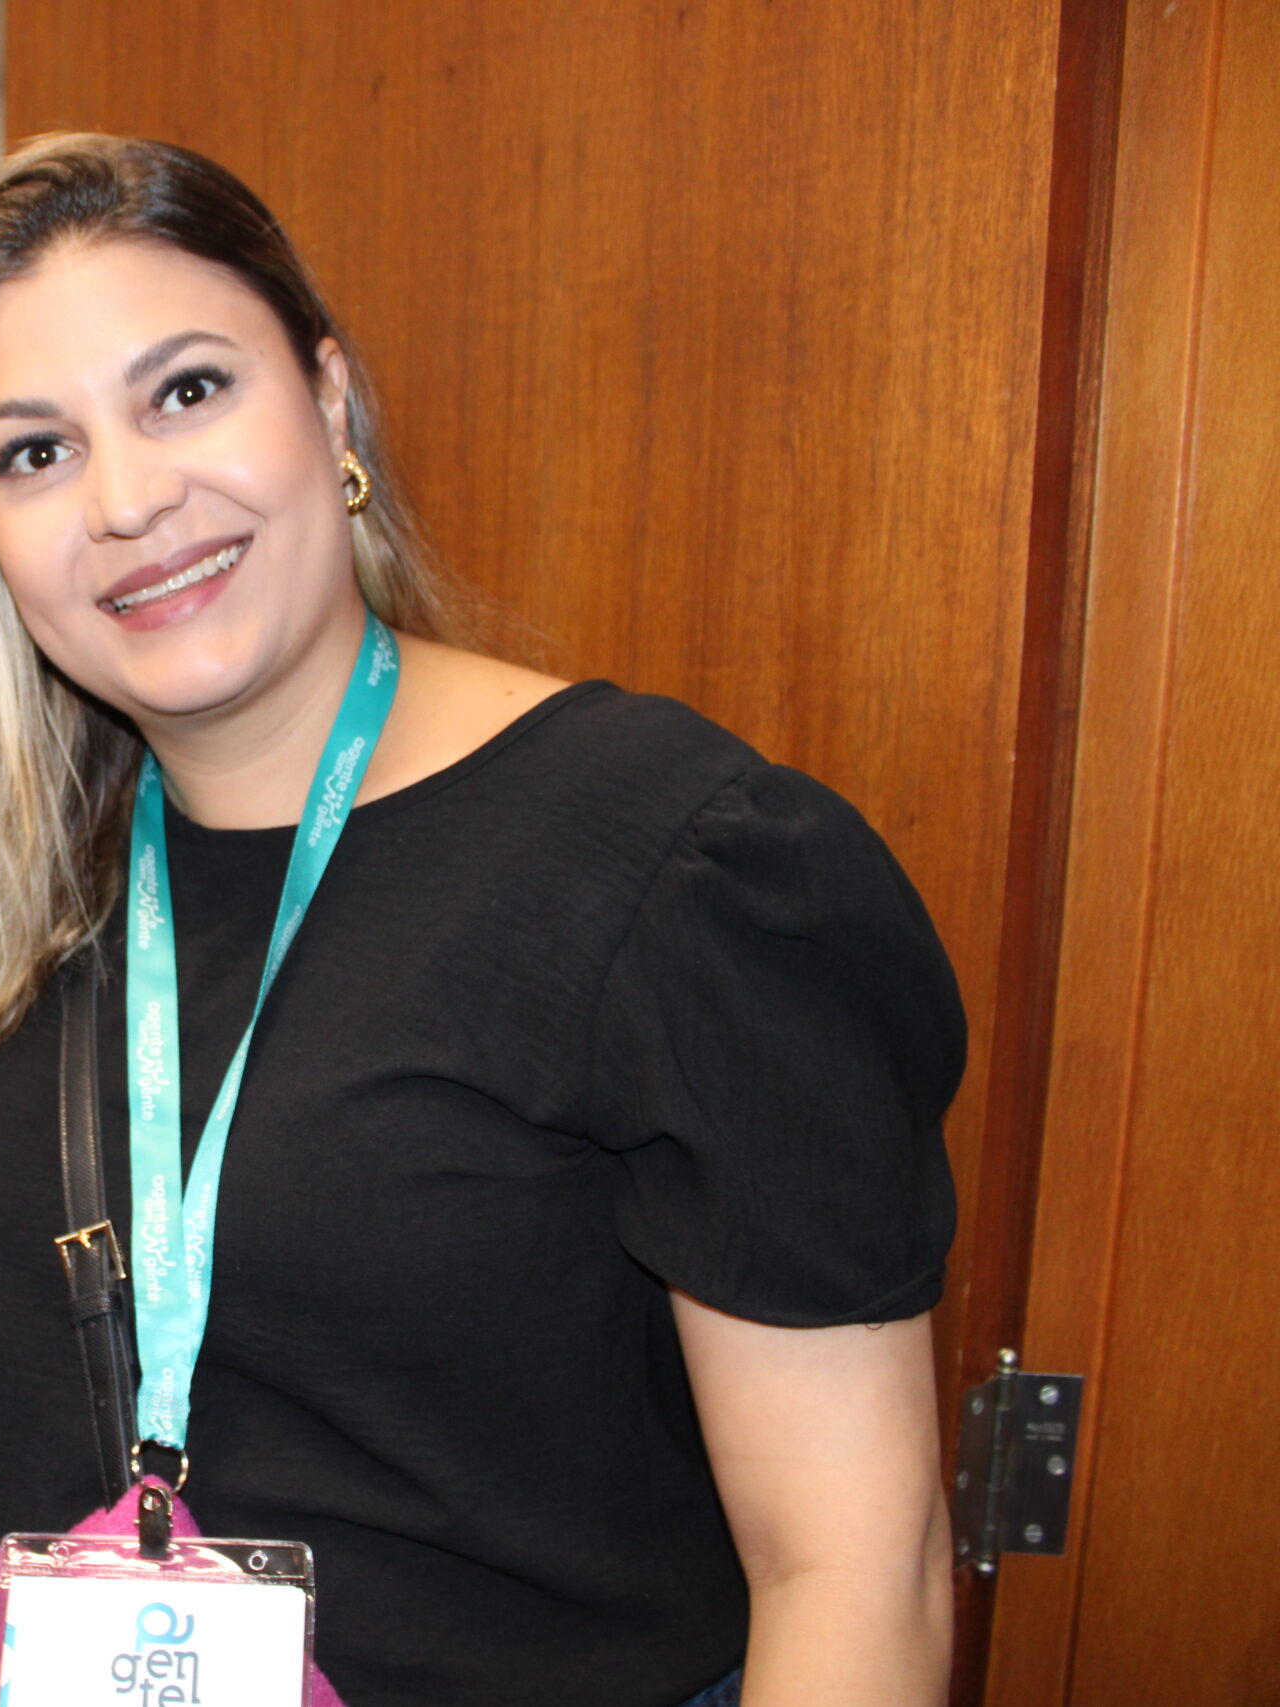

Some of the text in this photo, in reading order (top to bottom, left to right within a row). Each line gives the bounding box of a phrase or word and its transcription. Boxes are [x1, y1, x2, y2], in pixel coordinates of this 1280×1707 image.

[336, 736, 366, 792] agente
[307, 803, 329, 847] gente
[145, 1001, 164, 1057] agente
[138, 1076, 156, 1121] gente
[151, 1175, 168, 1235] agente
[142, 1256, 163, 1302] gente
